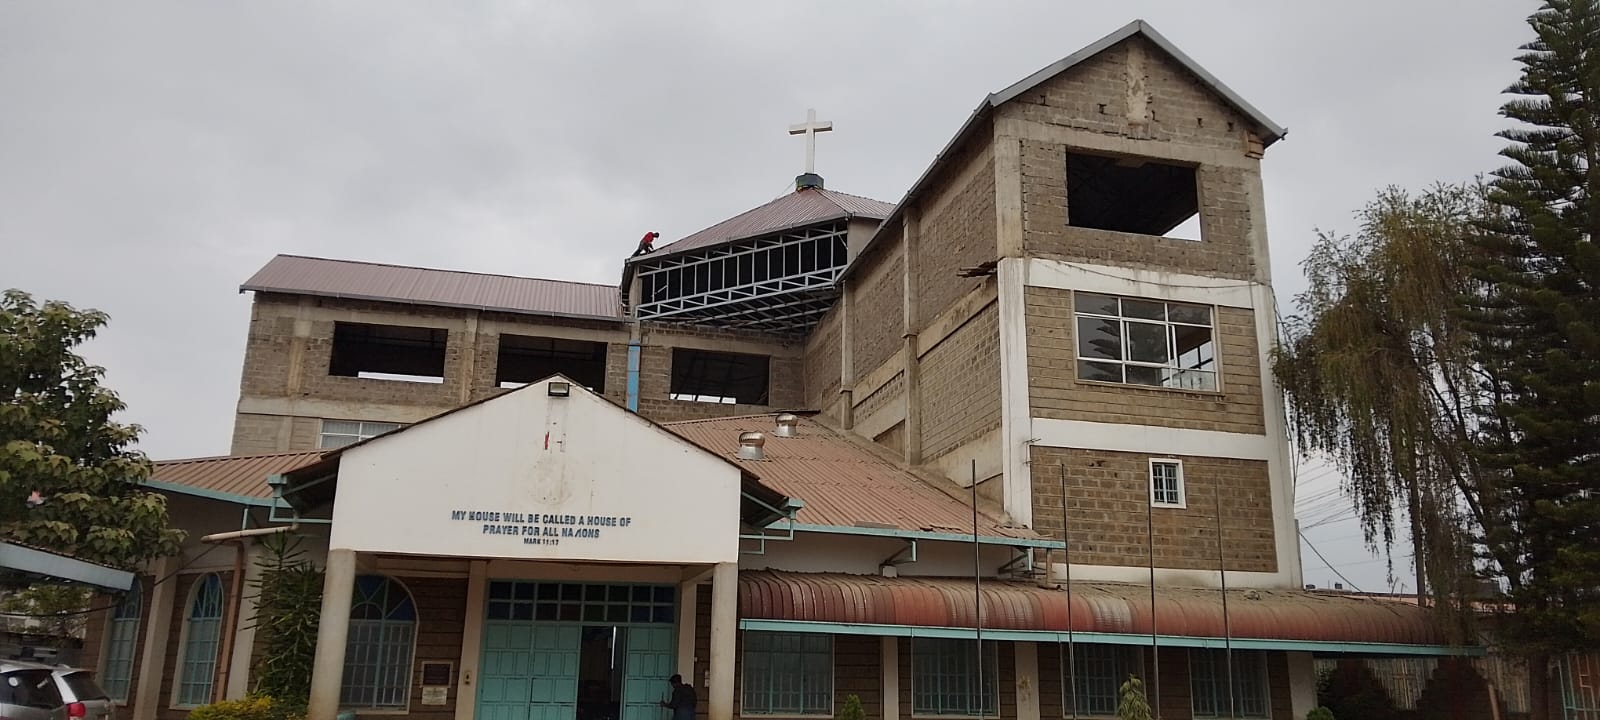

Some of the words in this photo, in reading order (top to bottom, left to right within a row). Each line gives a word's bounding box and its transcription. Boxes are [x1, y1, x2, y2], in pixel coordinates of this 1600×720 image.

[451, 510, 467, 521] MY
[503, 512, 525, 523] WILL
[527, 513, 540, 523] BE
[542, 514, 576, 525] CALLED
[578, 515, 585, 526] A
[587, 516, 617, 527] HOUSE
[619, 517, 631, 527] OF
[482, 524, 519, 536] PRAYER
[521, 526, 540, 536] FOR
[542, 527, 559, 537] ALL
